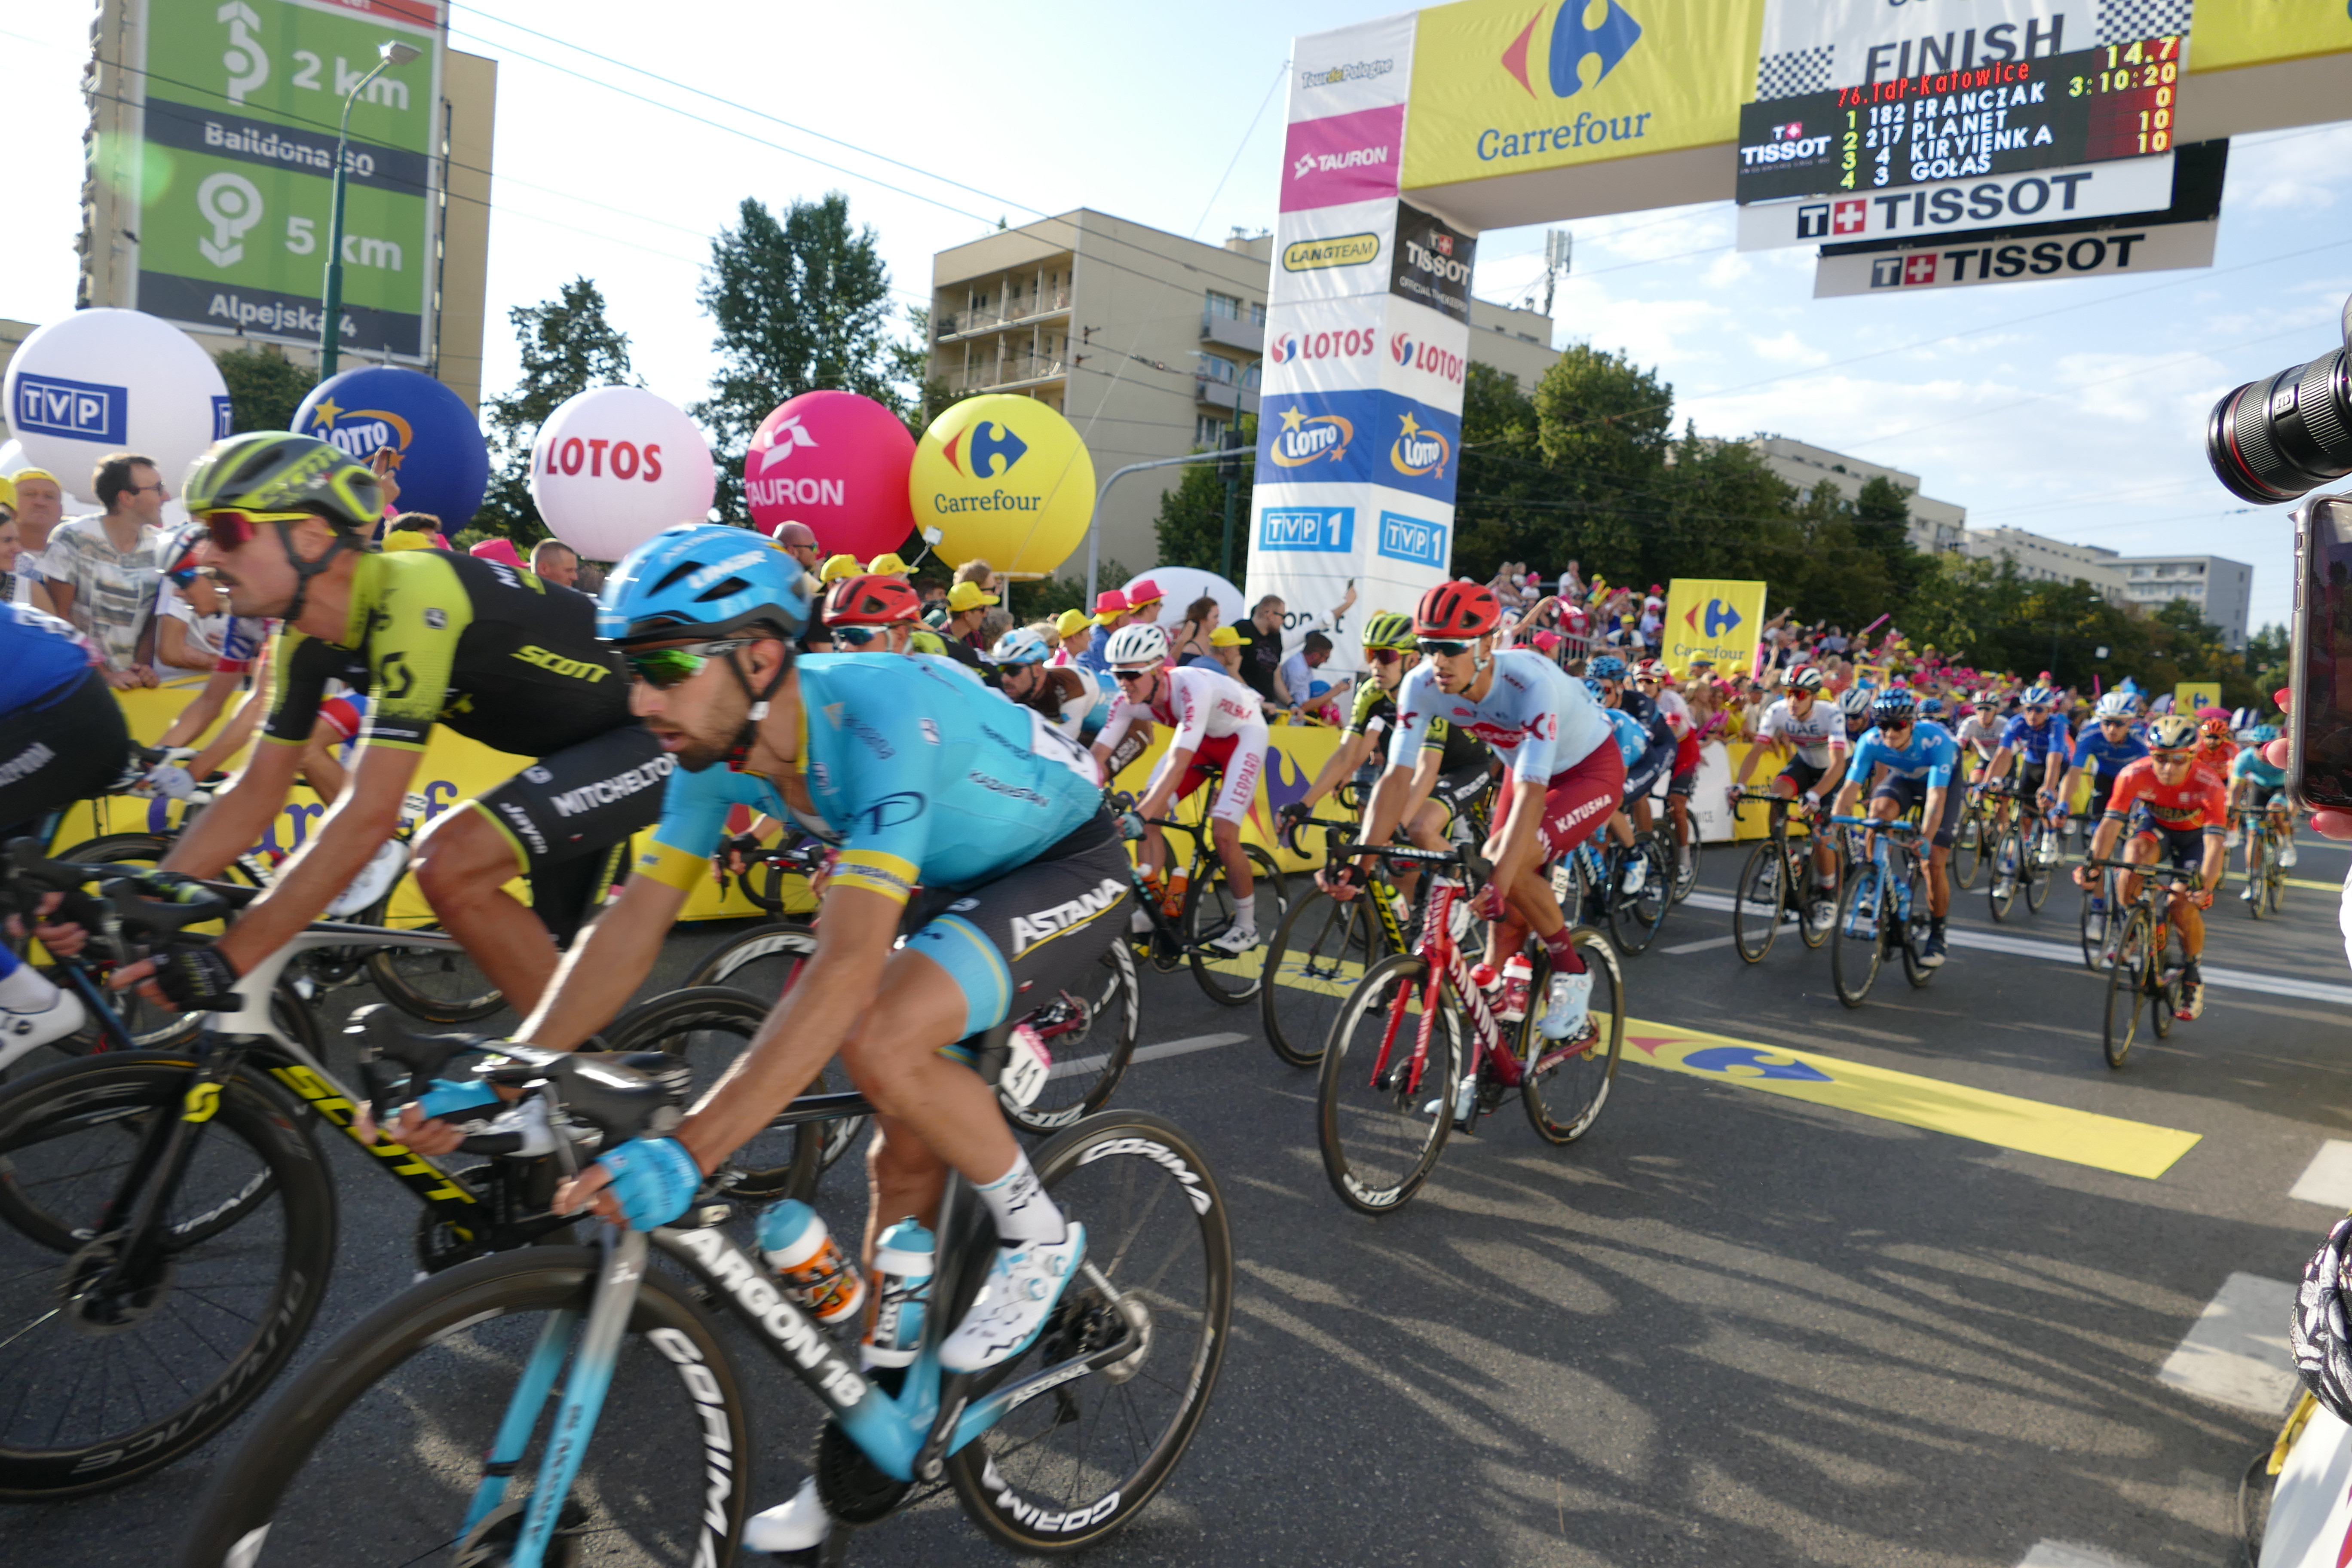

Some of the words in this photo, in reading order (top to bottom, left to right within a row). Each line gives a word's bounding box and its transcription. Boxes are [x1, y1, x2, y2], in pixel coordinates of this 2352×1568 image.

[1865, 14, 2064, 86] FINISH
[2107, 35, 2179, 69] 14.7
[293, 51, 321, 91] 2
[335, 56, 409, 110] km
[1846, 110, 1856, 129] 1
[1870, 103, 1906, 126] 182
[2068, 61, 2177, 98] 3:10:20
[1477, 112, 1651, 161] Carrefour
[1841, 151, 1857, 170] 3
[1875, 146, 1891, 165] 4
[2138, 108, 2170, 132] 10
[1843, 131, 1859, 151] 2
[1865, 124, 1904, 149] 217
[1912, 109, 2008, 140] PLANET
[2156, 86, 2171, 107] 0
[205, 121, 330, 168] Baildona
[1318, 146, 1388, 172] TAURON
[1740, 135, 1831, 165] TISSOT
[1840, 171, 1855, 190] 4
[1873, 167, 1890, 187] 3
[2137, 130, 2168, 153] 10
[1874, 172, 2092, 229] TISSOT
[285, 216, 316, 255] 5
[1406, 239, 1470, 286] TISSOT
[1943, 235, 2144, 282] TISSOT
[339, 314, 357, 337] 4
[1303, 327, 1375, 360] LOTOS
[1415, 341, 1465, 384] LOTOS
[24, 389, 101, 426] TVP
[546, 436, 662, 482] LOTOS
[1286, 425, 1338, 457] LOTTO
[1404, 437, 1440, 467] LOTTO
[745, 478, 845, 508] TAURON
[934, 489, 1041, 515] Carrefour
[1270, 518, 1317, 540] TVP
[1327, 511, 1343, 546] 1
[1389, 526, 1427, 549] TVP
[1432, 529, 1442, 561] 1
[1283, 612, 1344, 633] ont
[509, 645, 612, 683] SCOTT
[1785, 722, 1819, 734] UAE
[1554, 794, 1612, 833] KATUSHA
[1010, 878, 1129, 954] ASTANA
[1078, 1137, 1213, 1215] CORIMA
[675, 1227, 831, 1369] ARGON
[820, 1358, 868, 1407] 18
[1006, 1364, 1092, 1411] ASTANA
[982, 1456, 1121, 1531] CORIMA
